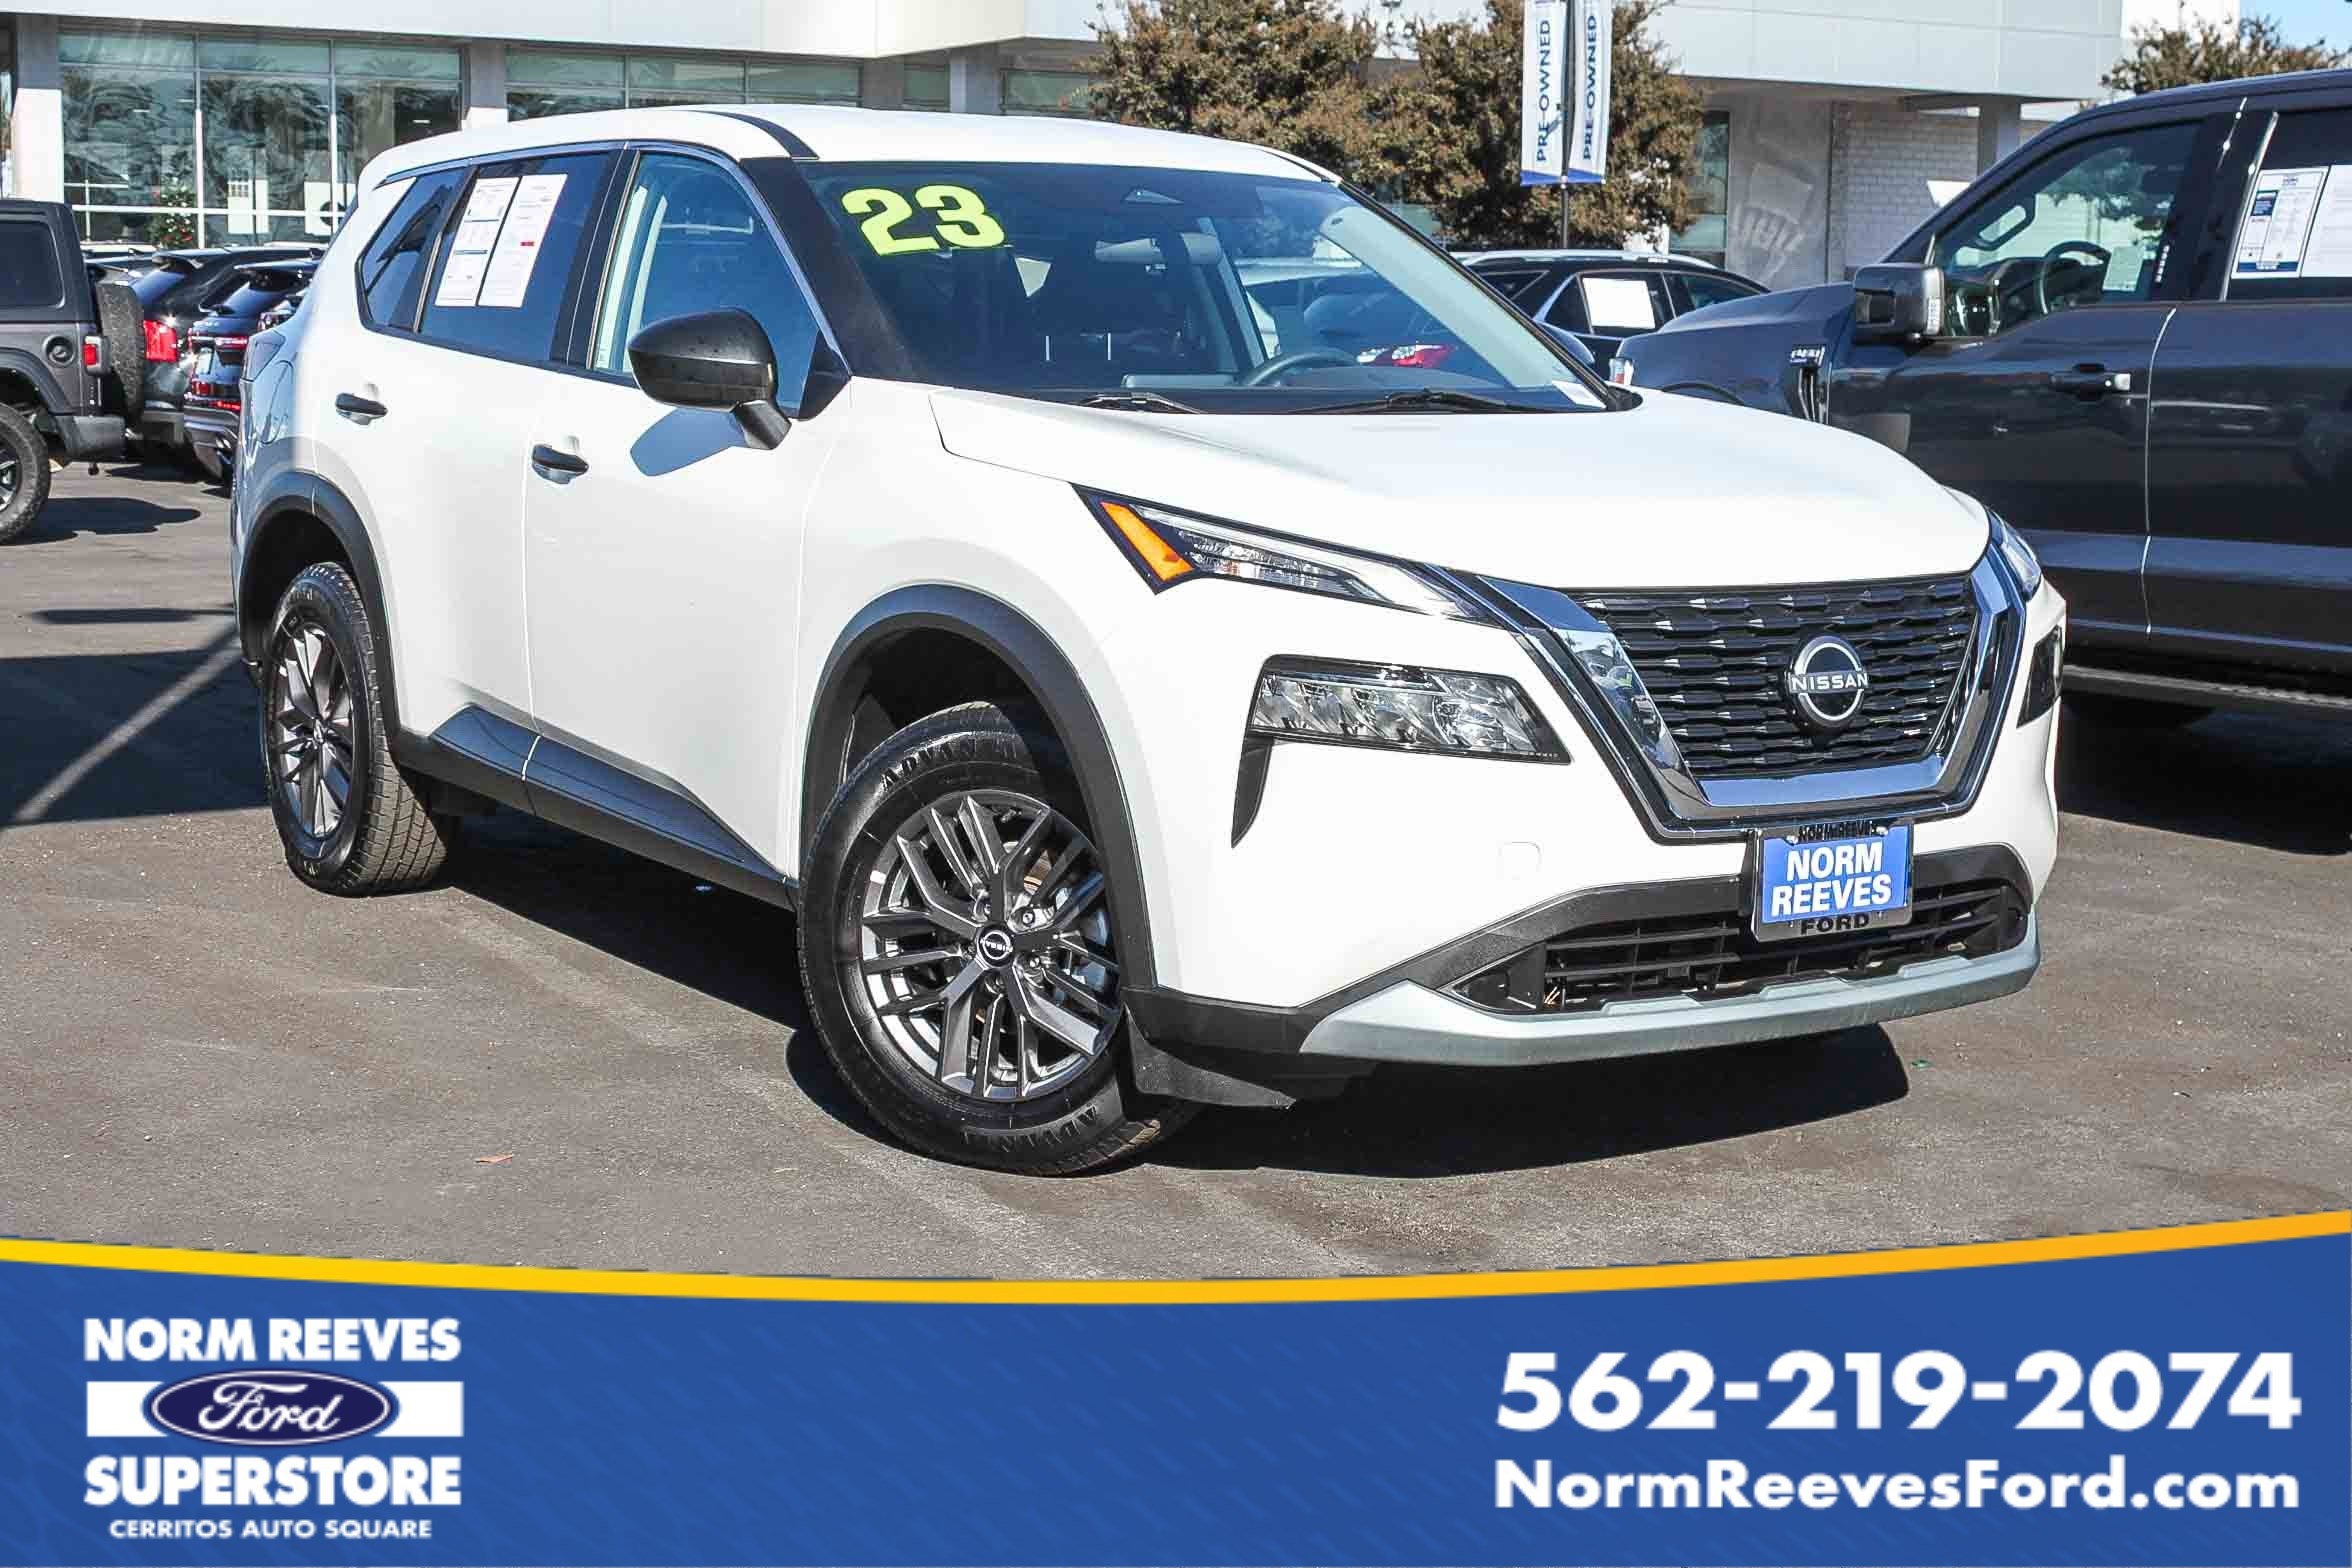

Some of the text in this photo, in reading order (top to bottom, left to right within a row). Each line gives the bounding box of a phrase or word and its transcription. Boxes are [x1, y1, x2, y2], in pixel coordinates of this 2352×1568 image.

[1536, 20, 1551, 162] PRE-OWNED
[1583, 15, 1597, 160] PRE-OWNED
[841, 184, 1005, 257] 23
[1791, 672, 1869, 691] NISSAN
[1787, 841, 1883, 882] NORM
[1771, 874, 1892, 917] REEVES
[1801, 913, 1870, 935] FORD
